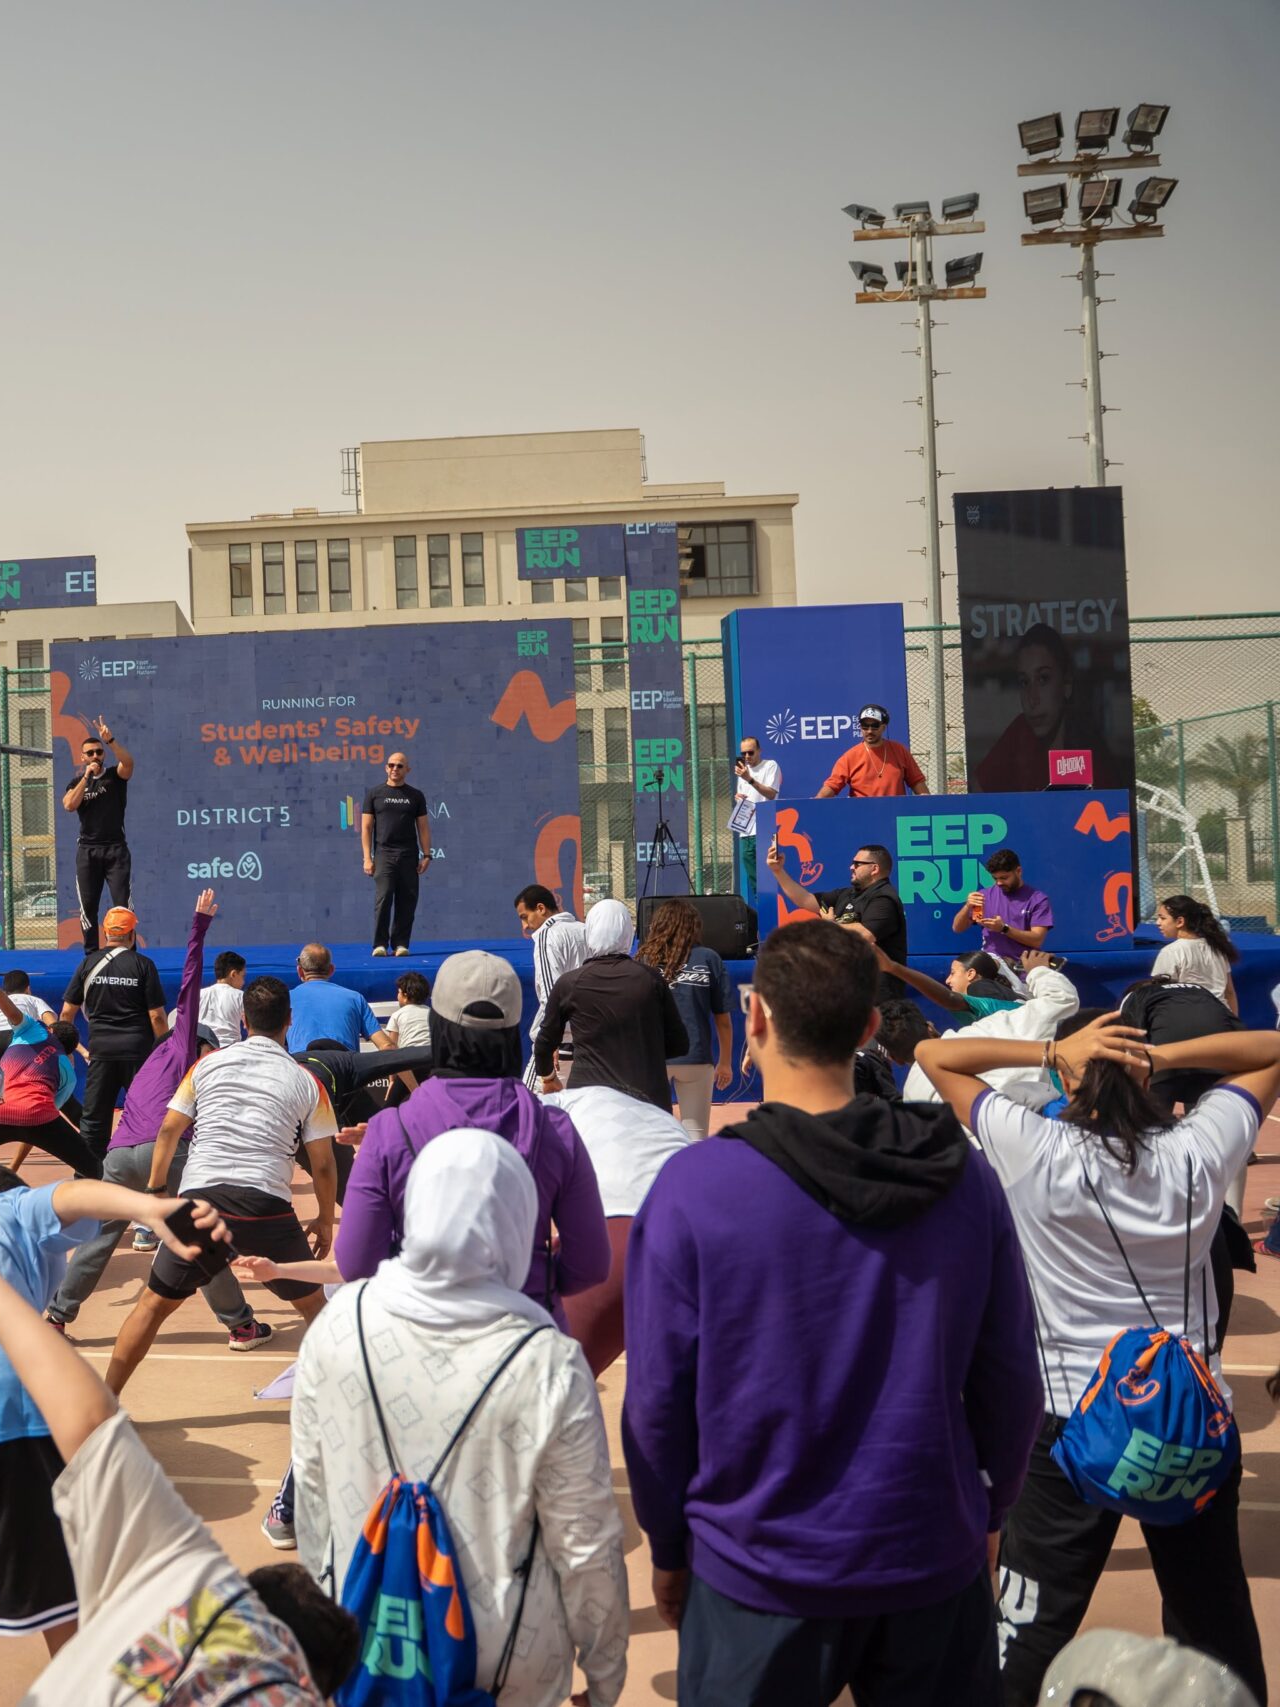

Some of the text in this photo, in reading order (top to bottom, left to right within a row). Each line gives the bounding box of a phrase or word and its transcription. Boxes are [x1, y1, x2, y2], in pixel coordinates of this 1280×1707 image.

[524, 528, 578, 548] EEP
[526, 548, 580, 568] RUN
[65, 570, 95, 592] EE
[630, 588, 677, 615] EEP
[630, 615, 679, 644] RUN
[970, 598, 1118, 639] STRATEGY
[517, 630, 548, 642] EEP
[518, 642, 548, 656] RUN
[102, 660, 136, 677] EEP
[262, 696, 356, 710] RUNNING FOR
[631, 690, 663, 710] EEP
[200, 714, 420, 742] Students' Safety
[800, 716, 852, 740] EEP
[214, 740, 384, 766] & Well-being
[634, 738, 682, 764] EEP
[177, 806, 290, 826] DISTRICT 5
[896, 814, 1008, 857] EEP
[187, 856, 234, 878] safe
[90, 976, 138, 986] POWERADE
[1122, 1428, 1222, 1477] EEP
[1107, 1456, 1210, 1502] RUN
